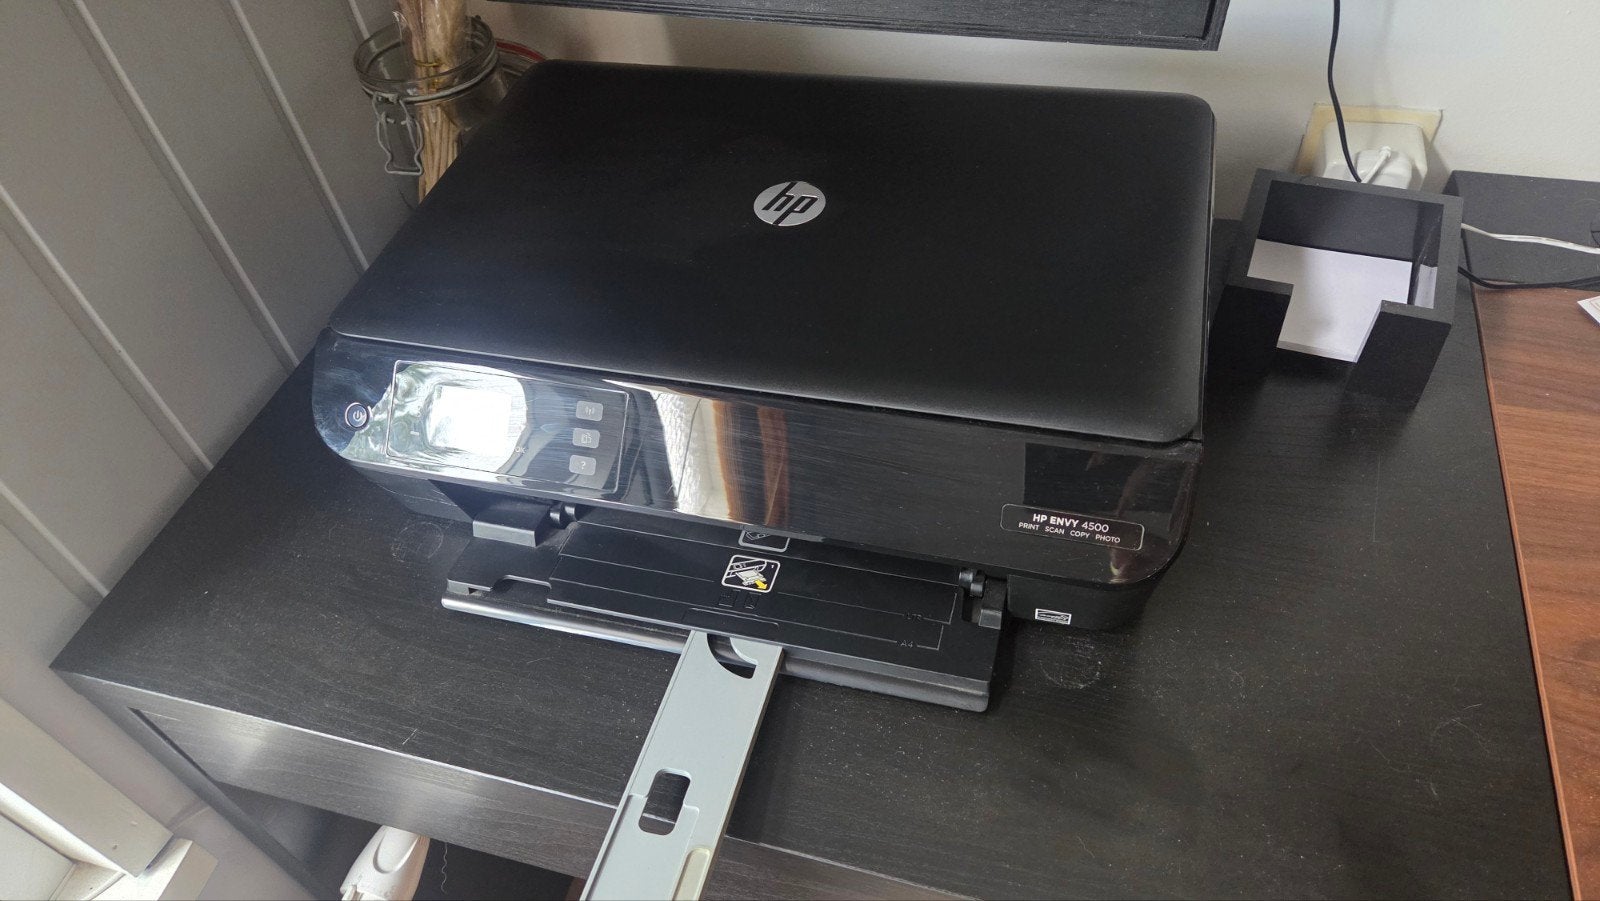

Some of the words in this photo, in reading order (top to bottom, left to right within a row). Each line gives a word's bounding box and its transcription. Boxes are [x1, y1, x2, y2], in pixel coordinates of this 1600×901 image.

[761, 181, 818, 226] hp
[1018, 522, 1039, 530] PRINT
[1045, 526, 1064, 534] SCAN
[1069, 530, 1090, 538] COPY
[1095, 534, 1120, 543] PHOTO
[1033, 514, 1047, 523] HP
[1050, 516, 1079, 528] ENVY
[1081, 521, 1109, 533] 4500
[901, 640, 913, 648] A4
